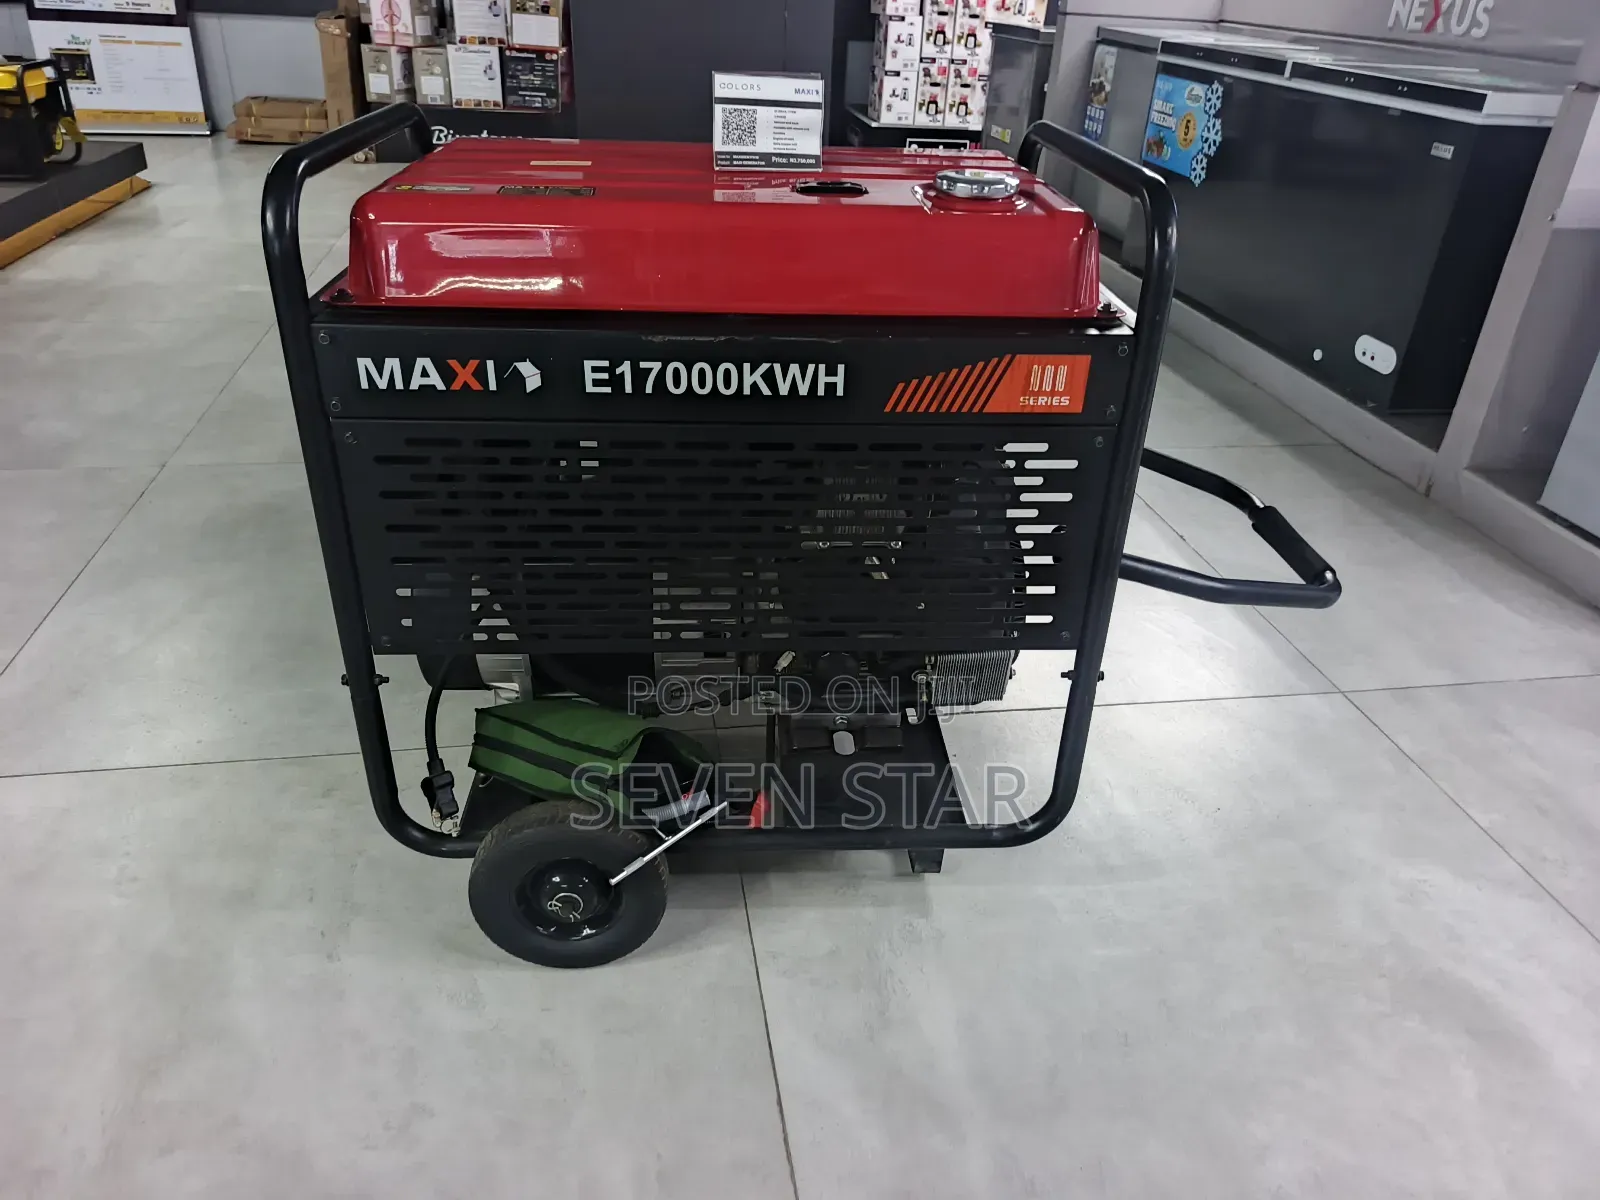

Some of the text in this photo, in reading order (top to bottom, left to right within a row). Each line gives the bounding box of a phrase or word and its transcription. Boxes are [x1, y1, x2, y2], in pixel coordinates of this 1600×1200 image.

[1387, 0, 1494, 38] NEXUS
[719, 82, 762, 91] COLORS
[794, 88, 814, 96] MAXI
[1183, 119, 1191, 137] 5
[771, 156, 789, 164] Price:
[356, 357, 845, 396] MAXI E17000KWH
[1019, 396, 1070, 406] SERIES
